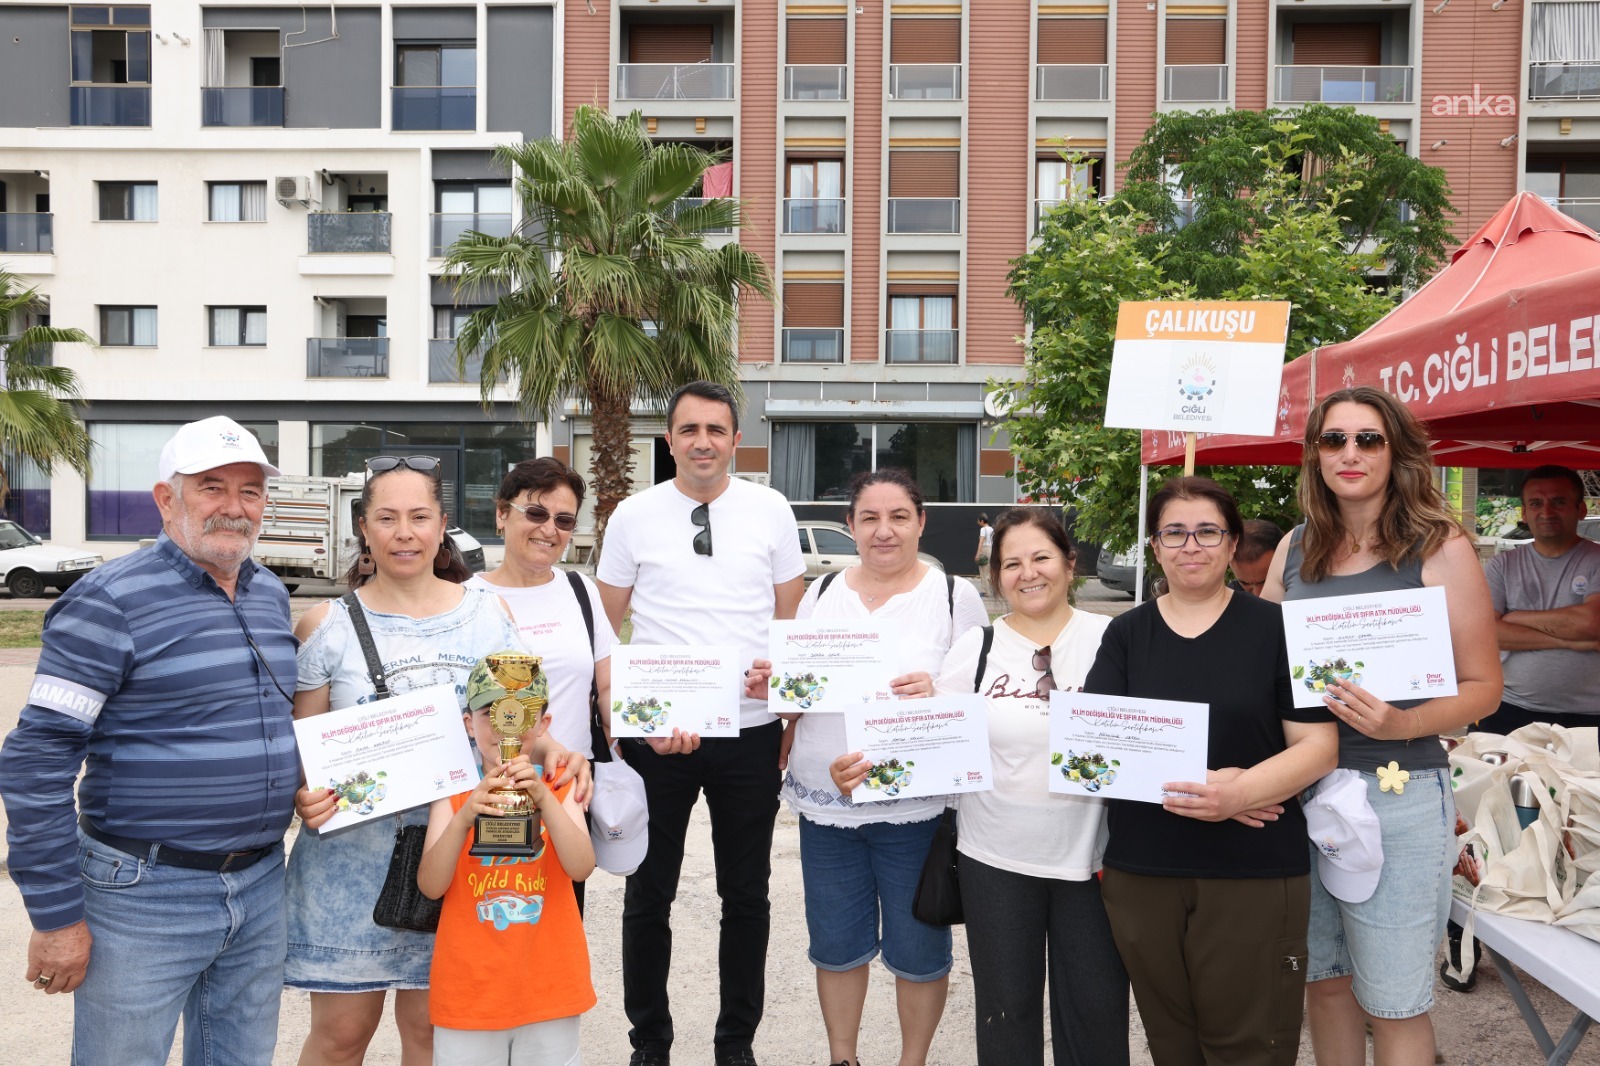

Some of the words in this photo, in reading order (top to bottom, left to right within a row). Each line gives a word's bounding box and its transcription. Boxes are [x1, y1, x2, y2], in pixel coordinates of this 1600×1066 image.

[1145, 309, 1256, 339] ÇALIKUŞU
[1423, 332, 1498, 404] ÇİĞLİ
[1506, 315, 1600, 381] BELE
[1181, 405, 1206, 414] ÇİĞLİ
[29, 682, 103, 718] KANARYA
[468, 869, 508, 897] Wild
